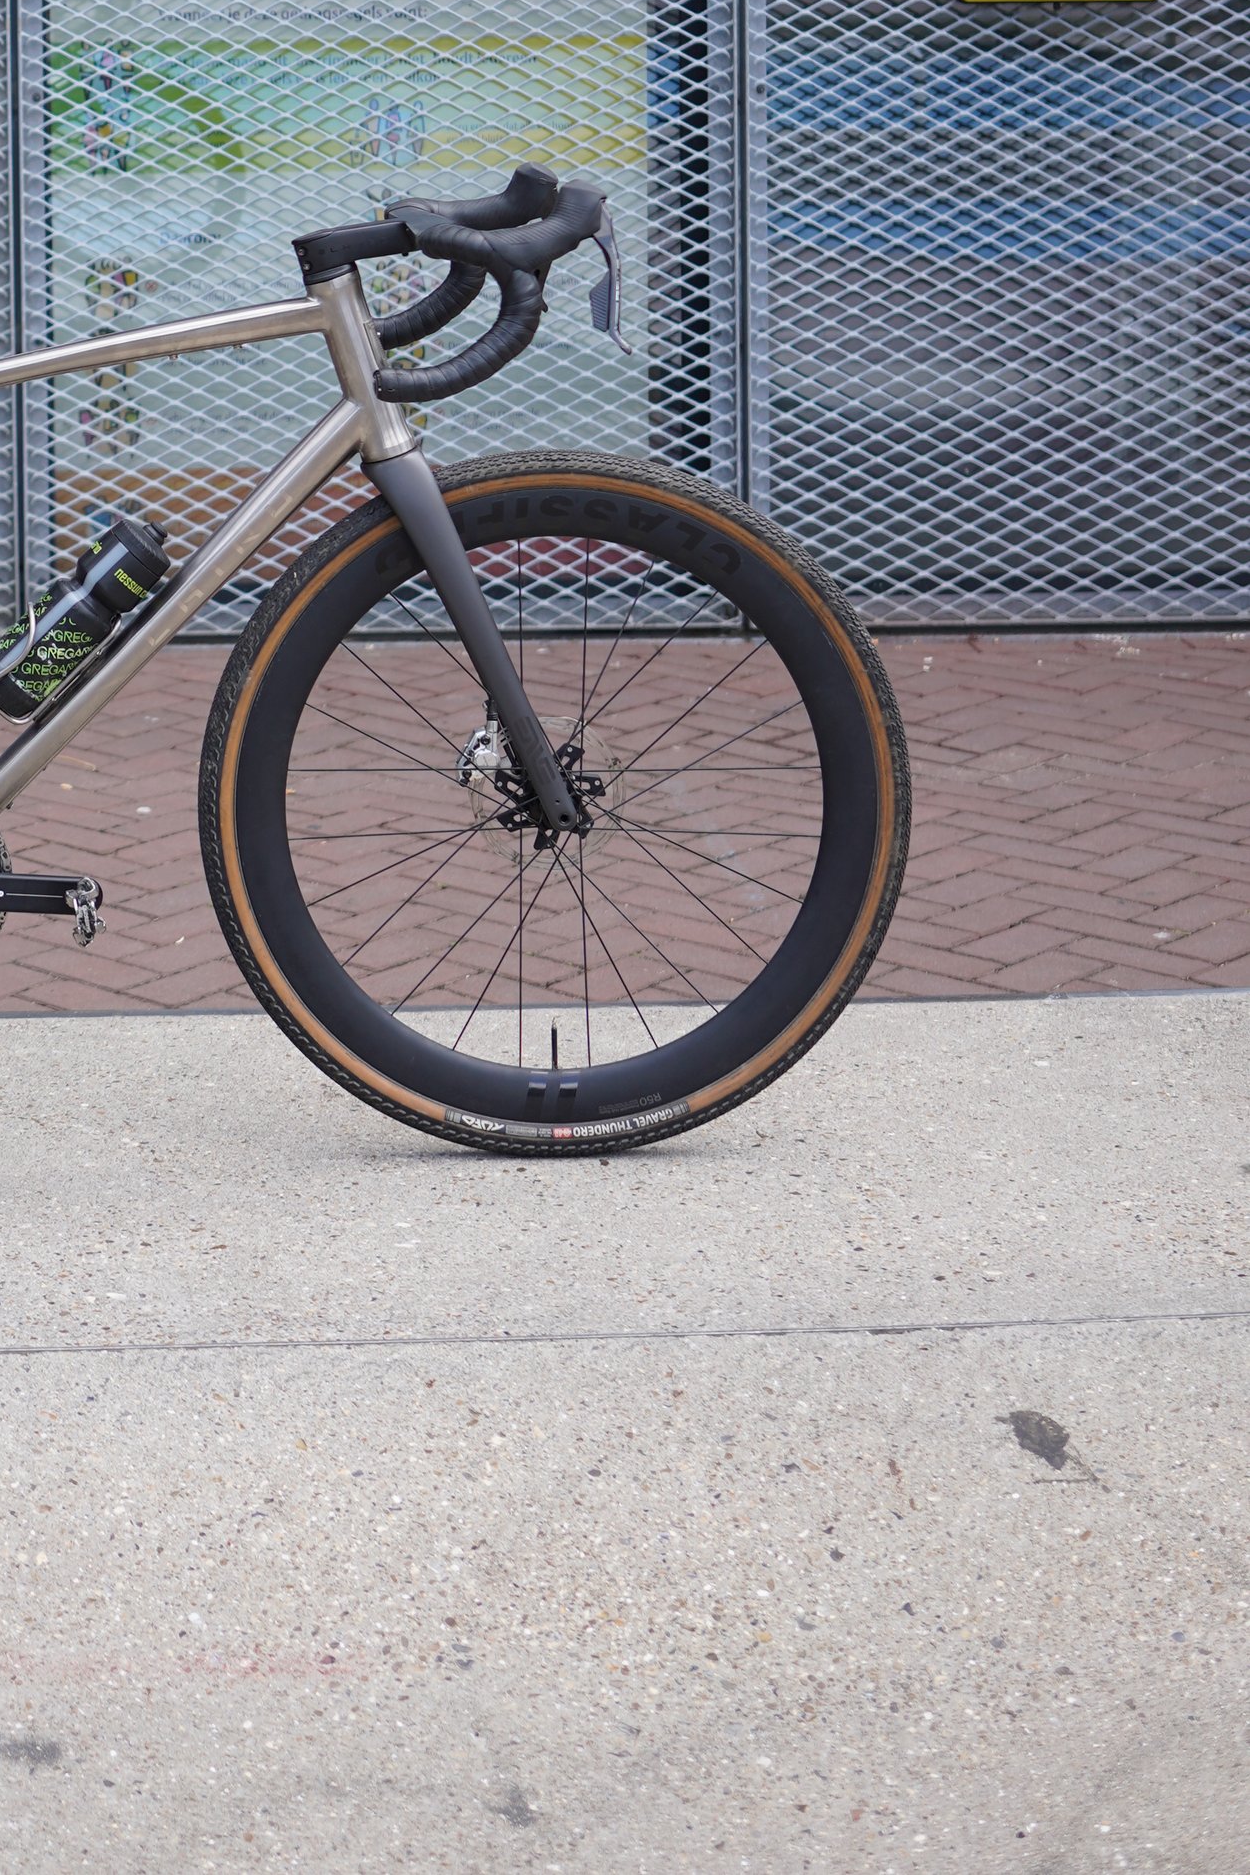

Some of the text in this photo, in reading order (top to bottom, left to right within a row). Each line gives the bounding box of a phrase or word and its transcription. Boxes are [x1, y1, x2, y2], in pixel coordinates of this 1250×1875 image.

[114, 568, 144, 596] nessun
[572, 1119, 633, 1137] THUNDERO
[632, 1107, 675, 1128] GRAVEL
